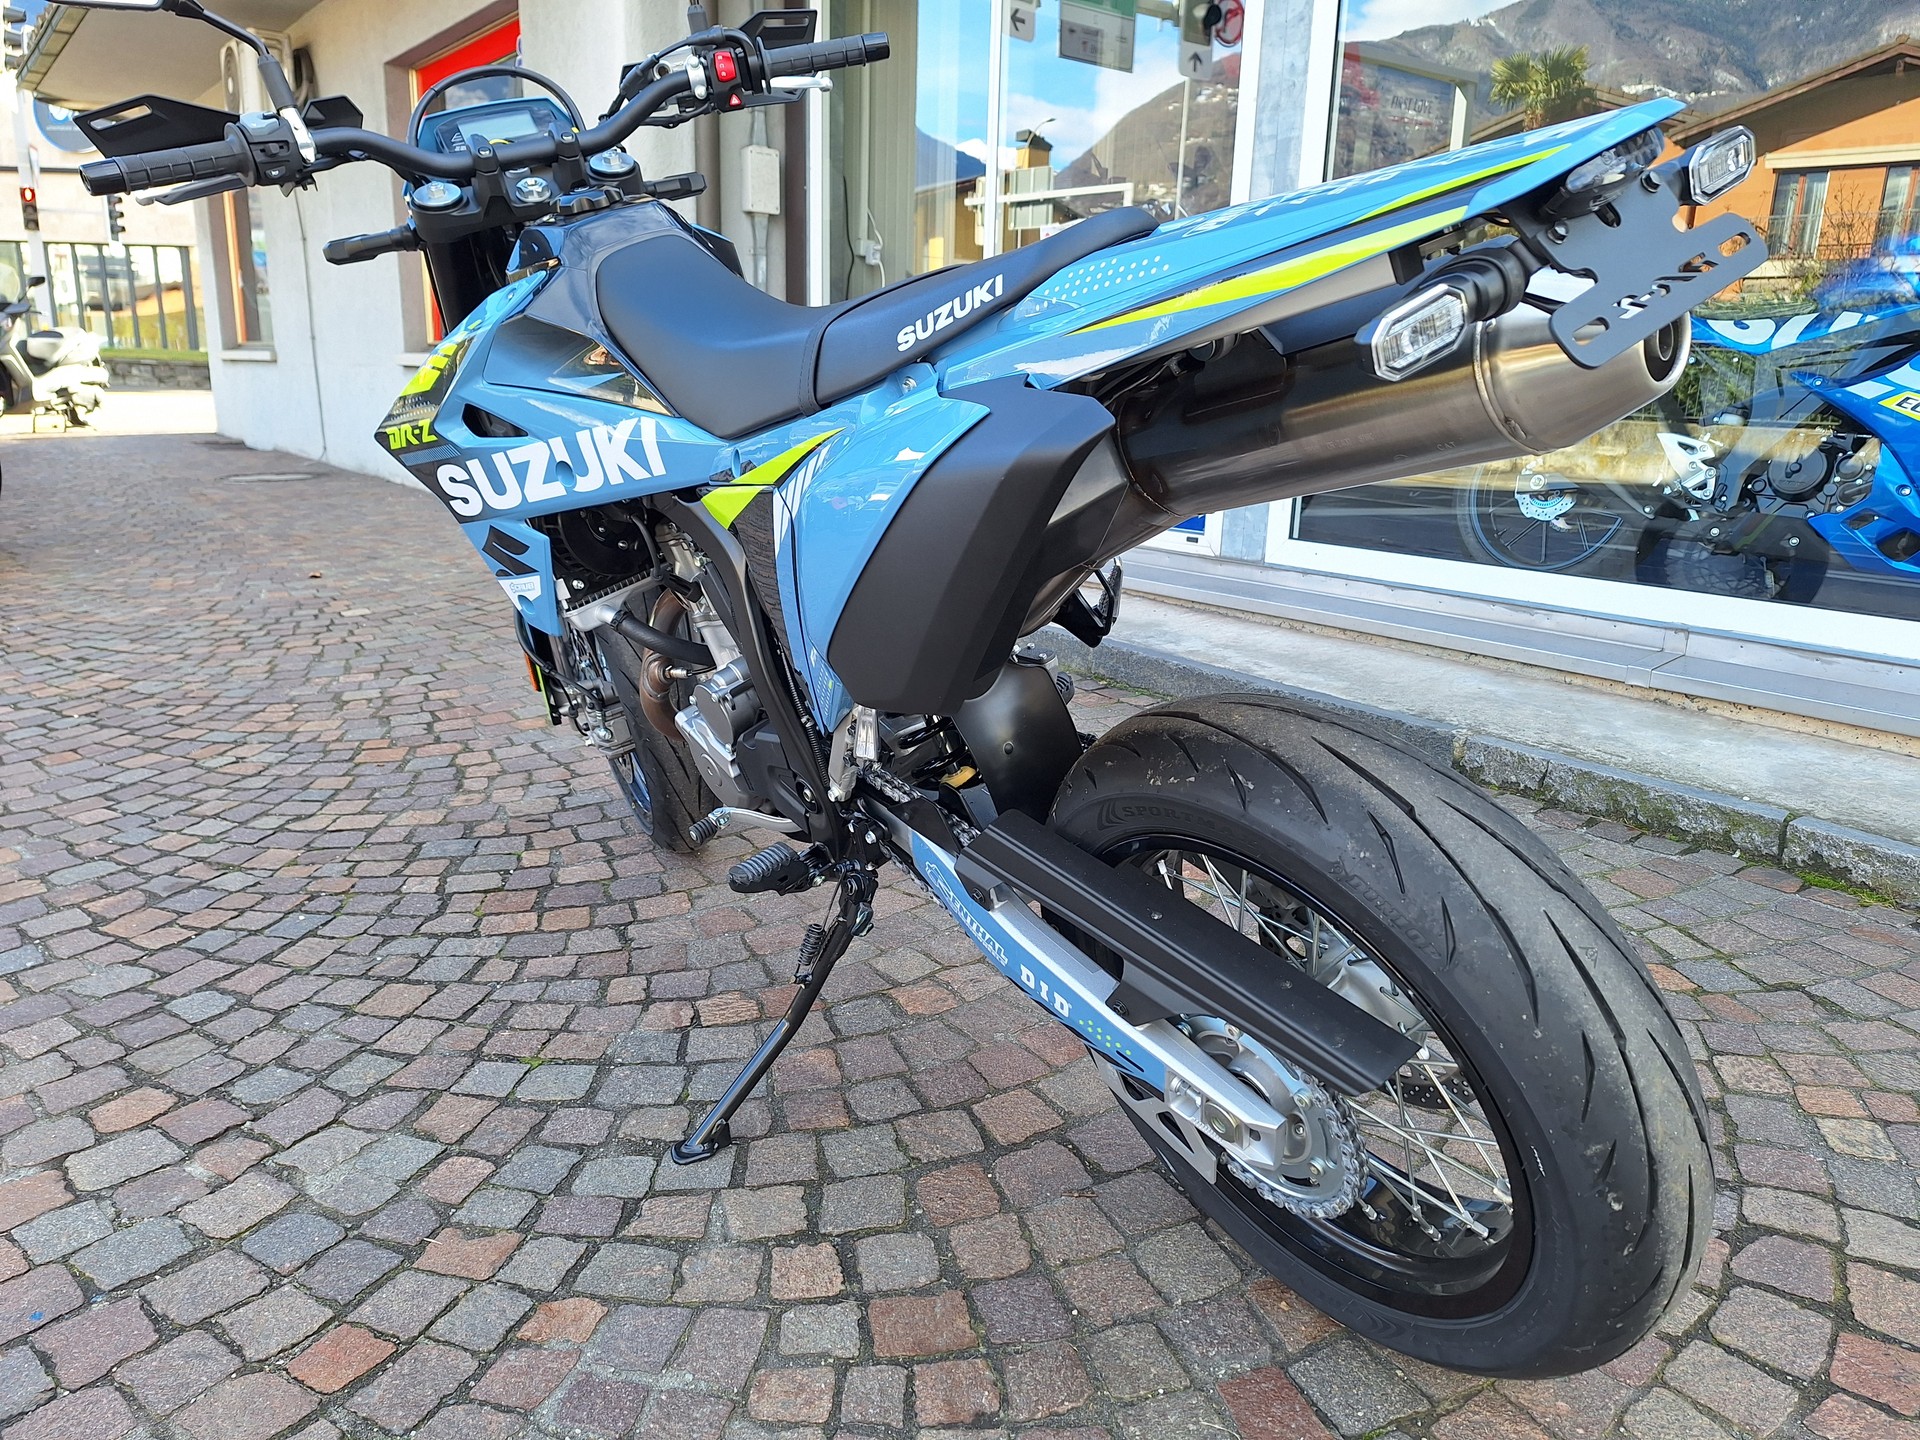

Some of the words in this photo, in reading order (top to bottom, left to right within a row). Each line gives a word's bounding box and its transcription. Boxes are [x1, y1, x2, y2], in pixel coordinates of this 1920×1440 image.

[897, 273, 1004, 352] SUZUKI
[385, 418, 438, 450] DR-Z
[437, 416, 667, 517] SUZUKI
